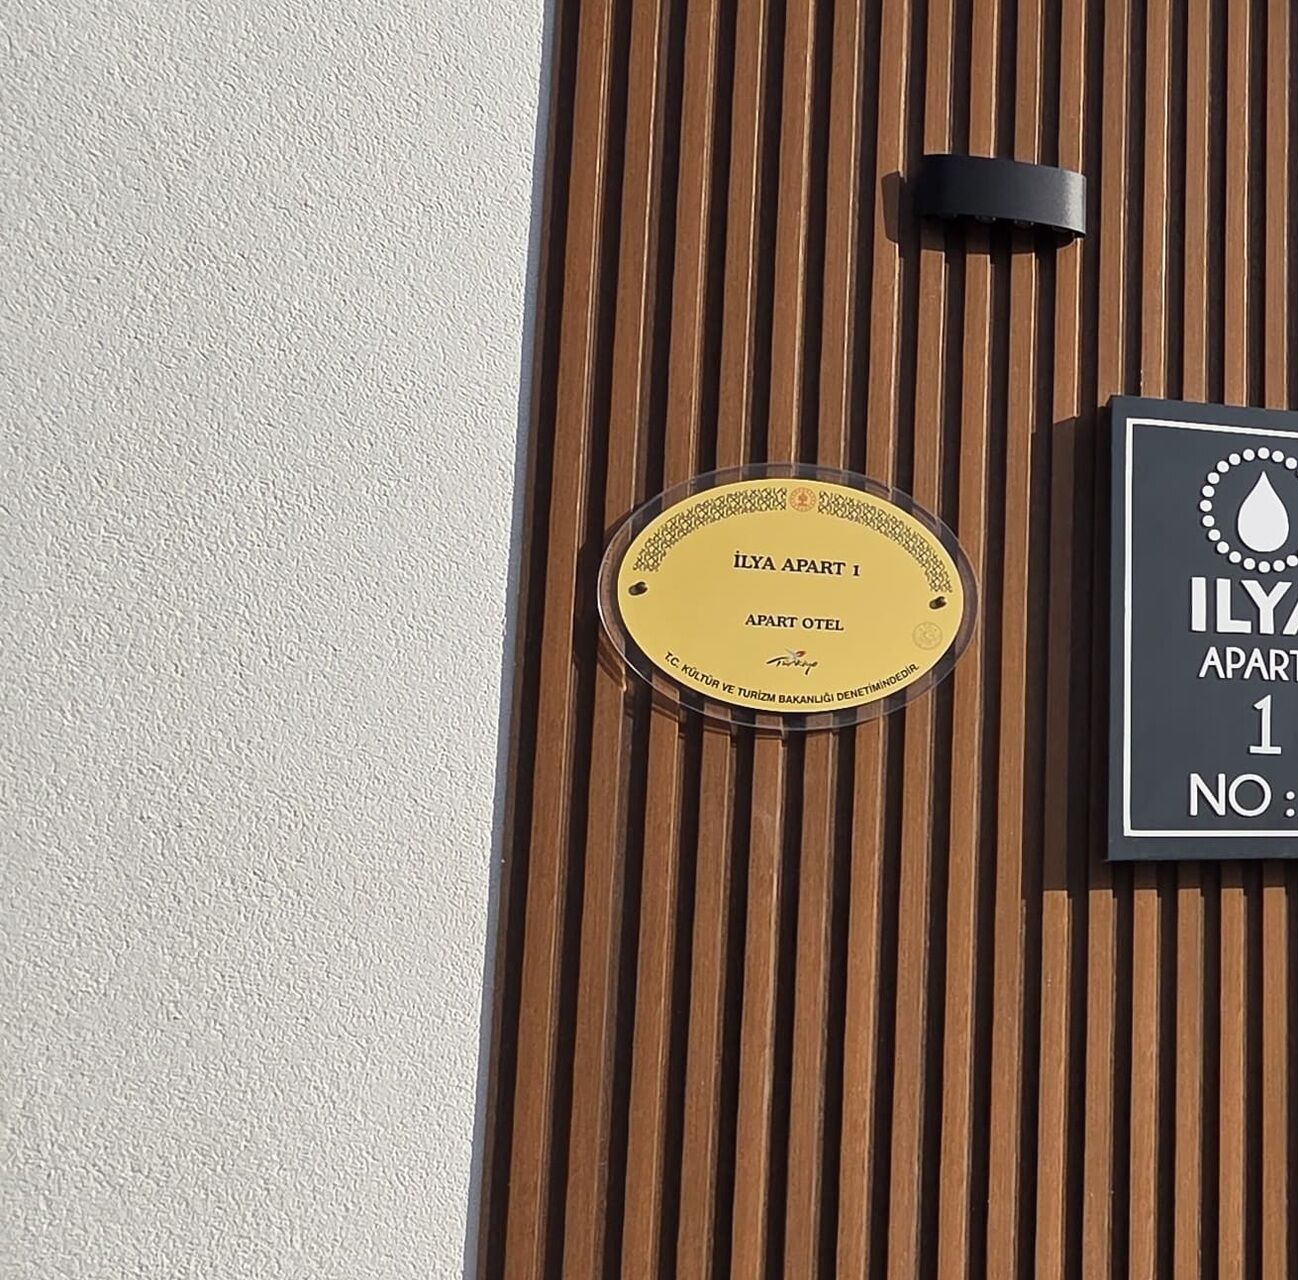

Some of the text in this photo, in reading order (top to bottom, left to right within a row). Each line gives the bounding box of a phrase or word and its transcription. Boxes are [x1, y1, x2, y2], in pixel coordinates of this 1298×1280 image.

[734, 550, 776, 571] İLYA
[781, 558, 846, 575] APART
[745, 614, 844, 631] APART OTEL
[664, 651, 680, 669] T.C.
[681, 664, 720, 689] KÜLTÜR
[722, 682, 735, 694] VE
[737, 687, 776, 703] TURİZM
[778, 692, 834, 704] BAKANLIĞI
[1249, 694, 1282, 755] 1
